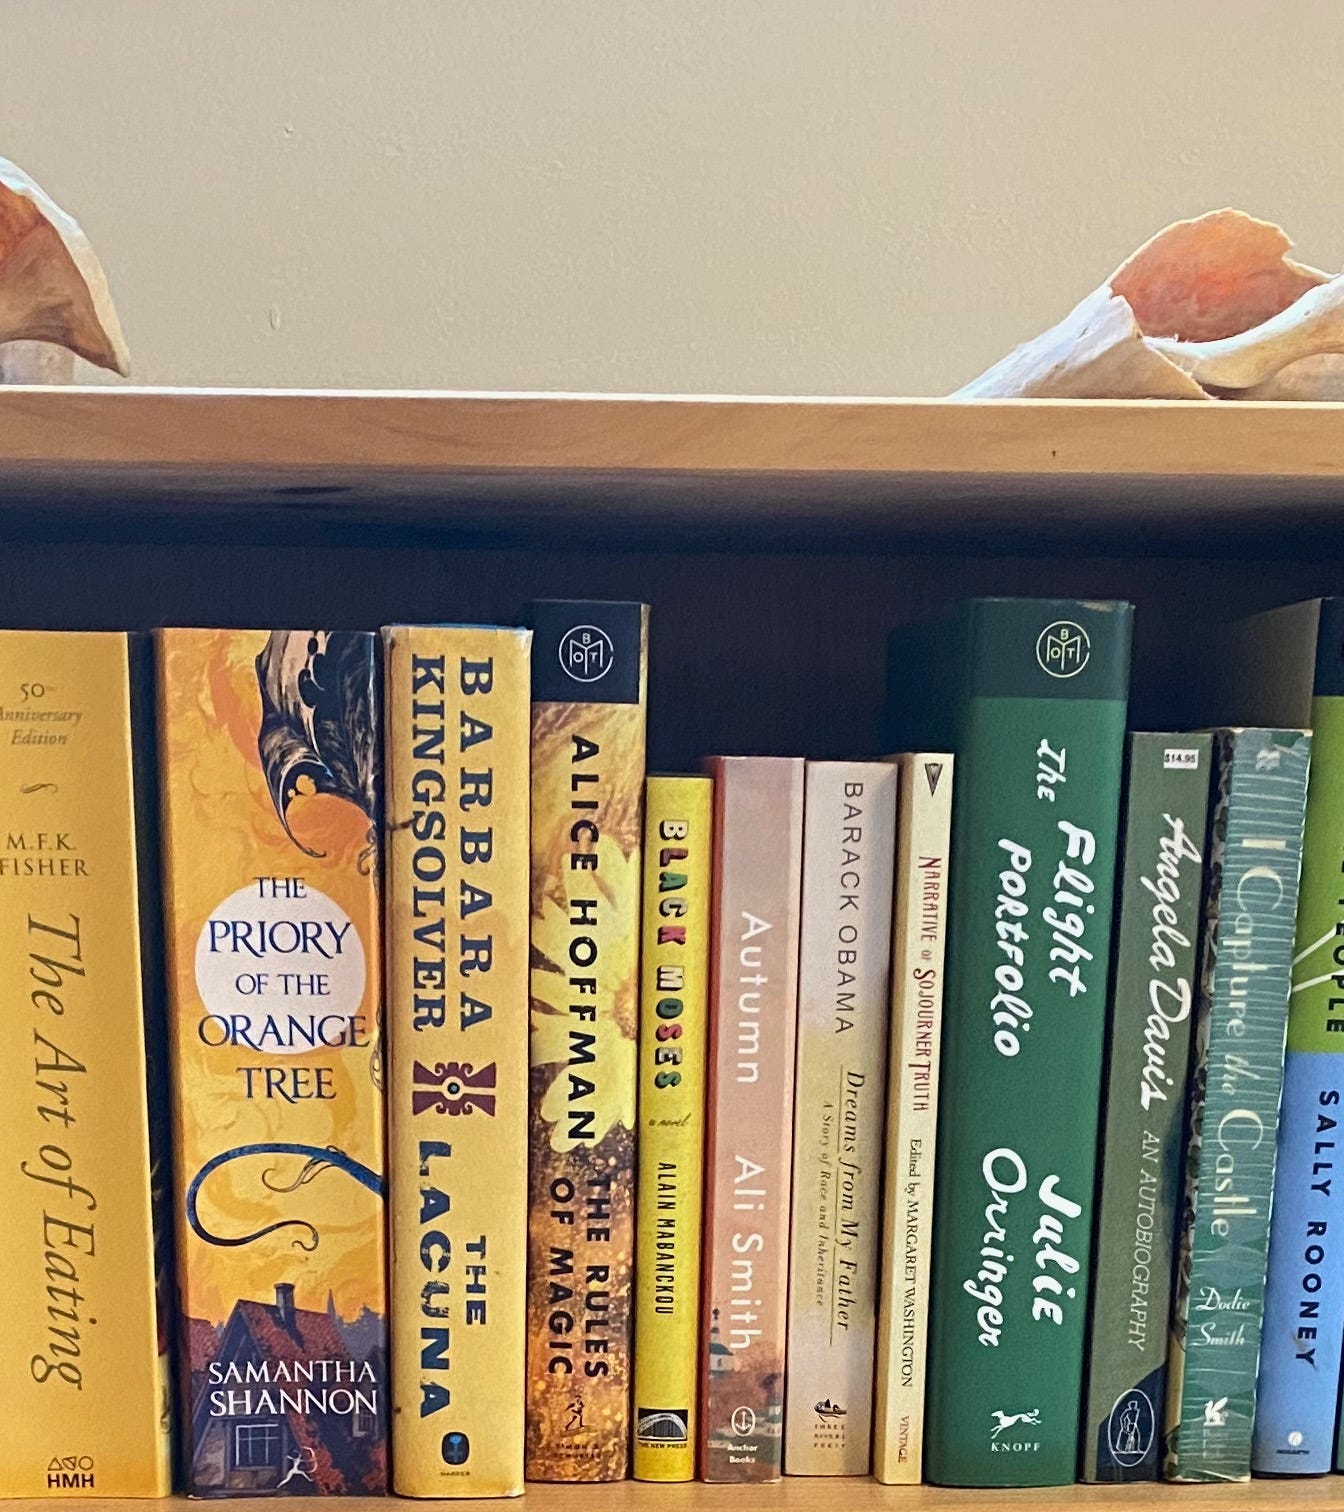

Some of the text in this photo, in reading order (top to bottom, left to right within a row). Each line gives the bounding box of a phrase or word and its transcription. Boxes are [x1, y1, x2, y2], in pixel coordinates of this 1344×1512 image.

[10, 731, 68, 747] Edition
[412, 655, 447, 1031] KINGSOLVER
[459, 657, 494, 1031] BARBARA
[208, 921, 351, 958] PRIORY
[568, 735, 599, 1140] ALICE HOFFMAN
[737, 911, 772, 1083] Autumn
[835, 783, 864, 1034] BARACK OBAMA
[1140, 813, 1202, 1111] Angela Davis
[21, 913, 98, 1391] The Art of Eating
[654, 1162, 675, 1315] ALAIN MABANCKOU
[901, 1139, 921, 1387] Edited by MARGARET WASHINGTON
[1128, 1130, 1159, 1352] AN AUTOBIOGRAPHY
[1295, 1091, 1340, 1370] SALLY ROONEY
[1196, 1285, 1250, 1312] Dodie
[47, 1474, 94, 1488] HMH
[898, 1416, 910, 1463] VINTAGE
